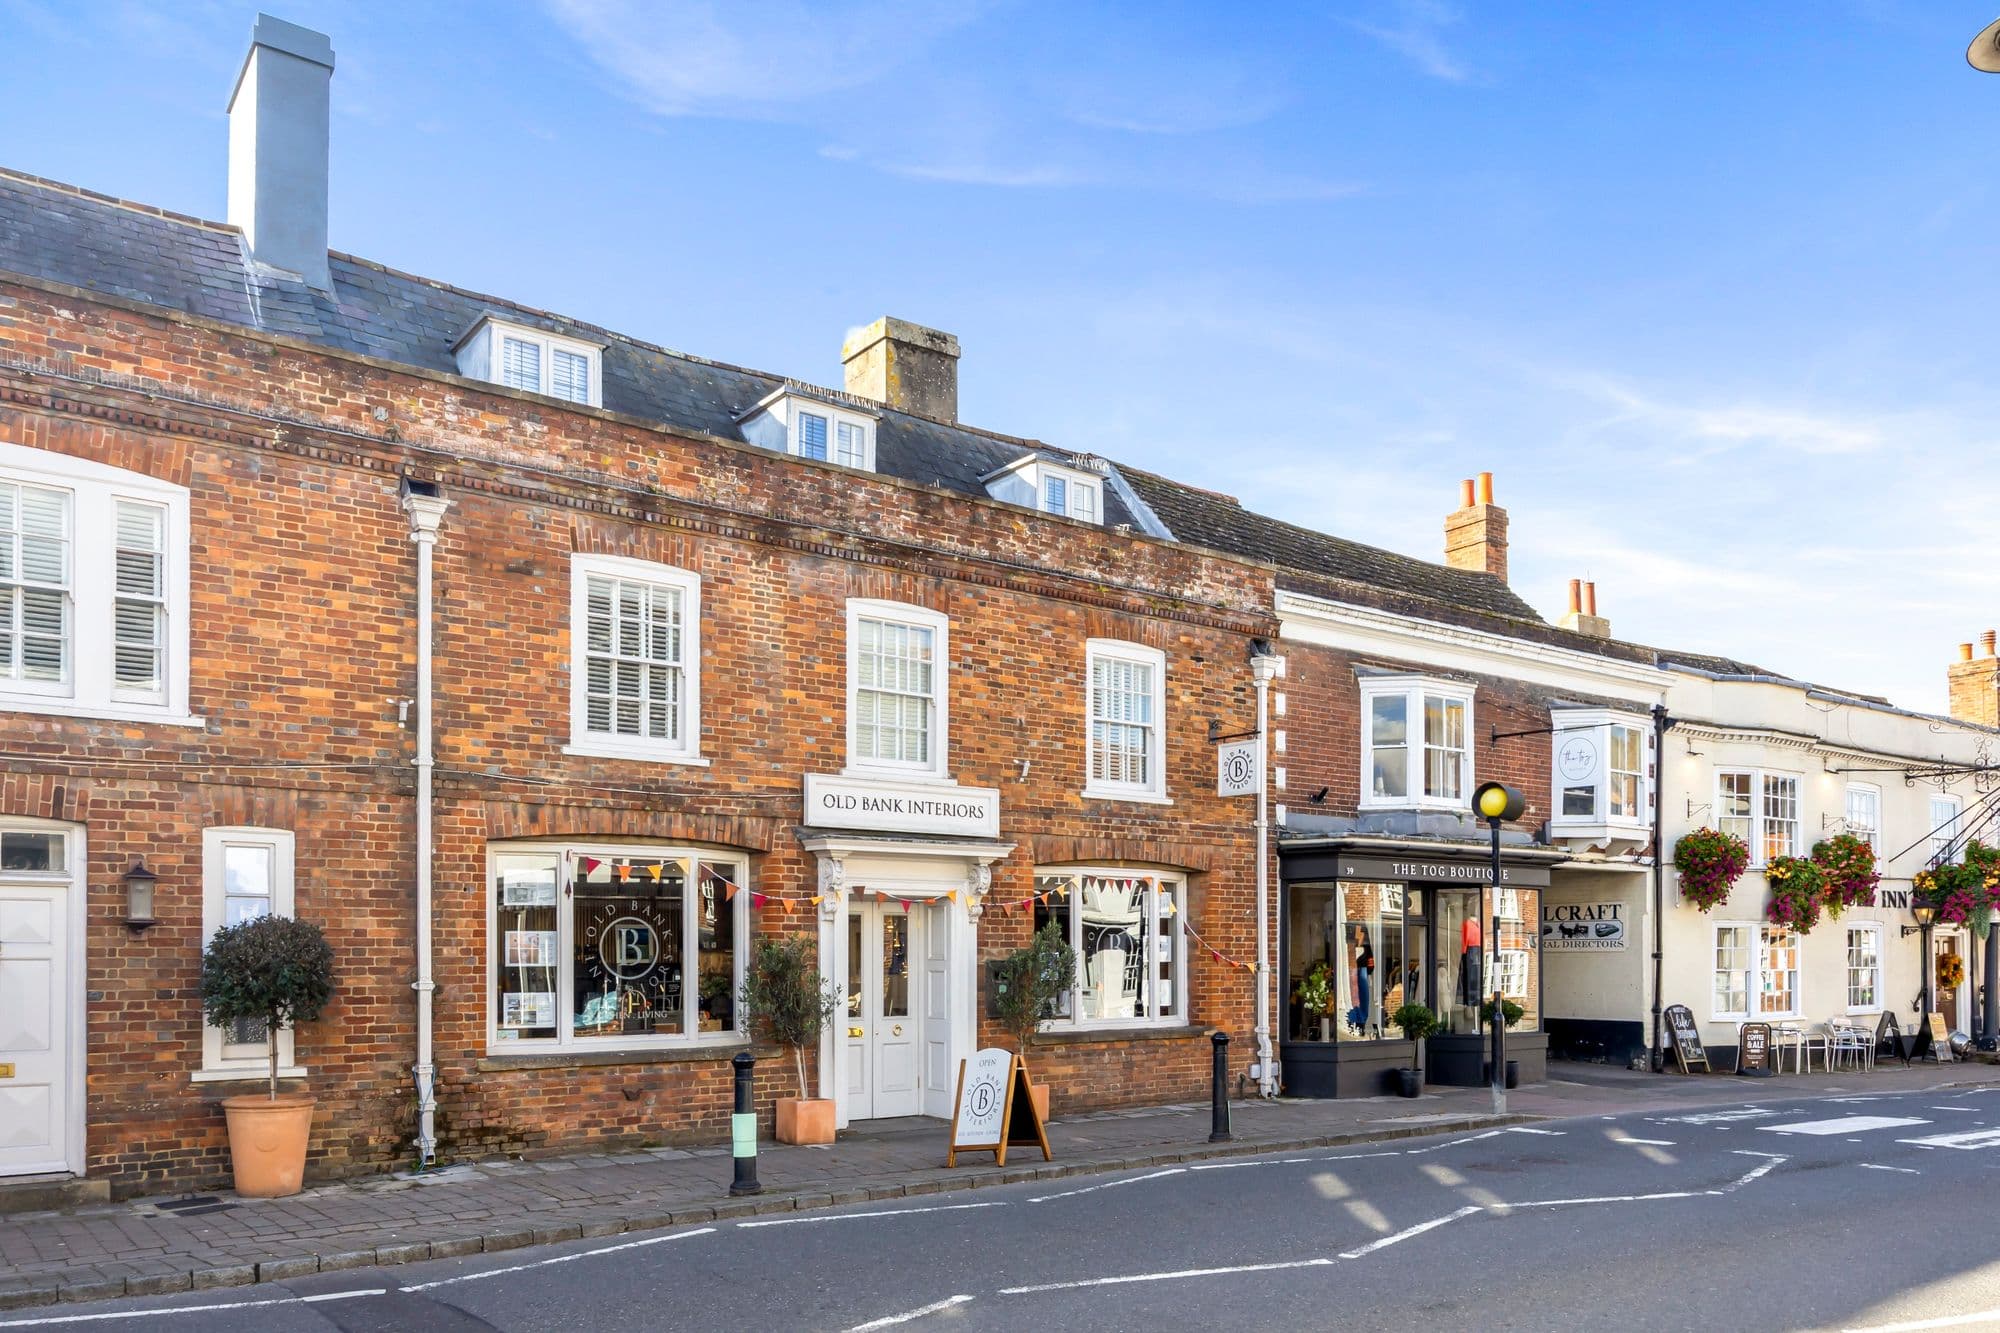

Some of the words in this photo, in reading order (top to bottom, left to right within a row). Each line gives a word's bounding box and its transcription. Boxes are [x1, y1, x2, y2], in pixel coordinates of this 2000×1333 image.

[1235, 760, 1243, 777] B
[823, 793, 856, 810] OLD
[862, 796, 903, 814] BANK
[908, 800, 984, 819] INTERIORS
[1346, 867, 1354, 875] 39
[1392, 863, 1417, 876] THE
[1421, 864, 1445, 877] TOG
[1450, 866, 1509, 881] BOUTIQE
[1881, 890, 1907, 909] INN
[586, 904, 616, 937] OLD
[631, 900, 673, 940] BANK
[619, 928, 643, 966] B
[1562, 940, 1624, 948] DIRECTORS
[637, 1010, 668, 1019] LIVING
[978, 1058, 997, 1067] OPEN
[978, 1088, 988, 1110] B
